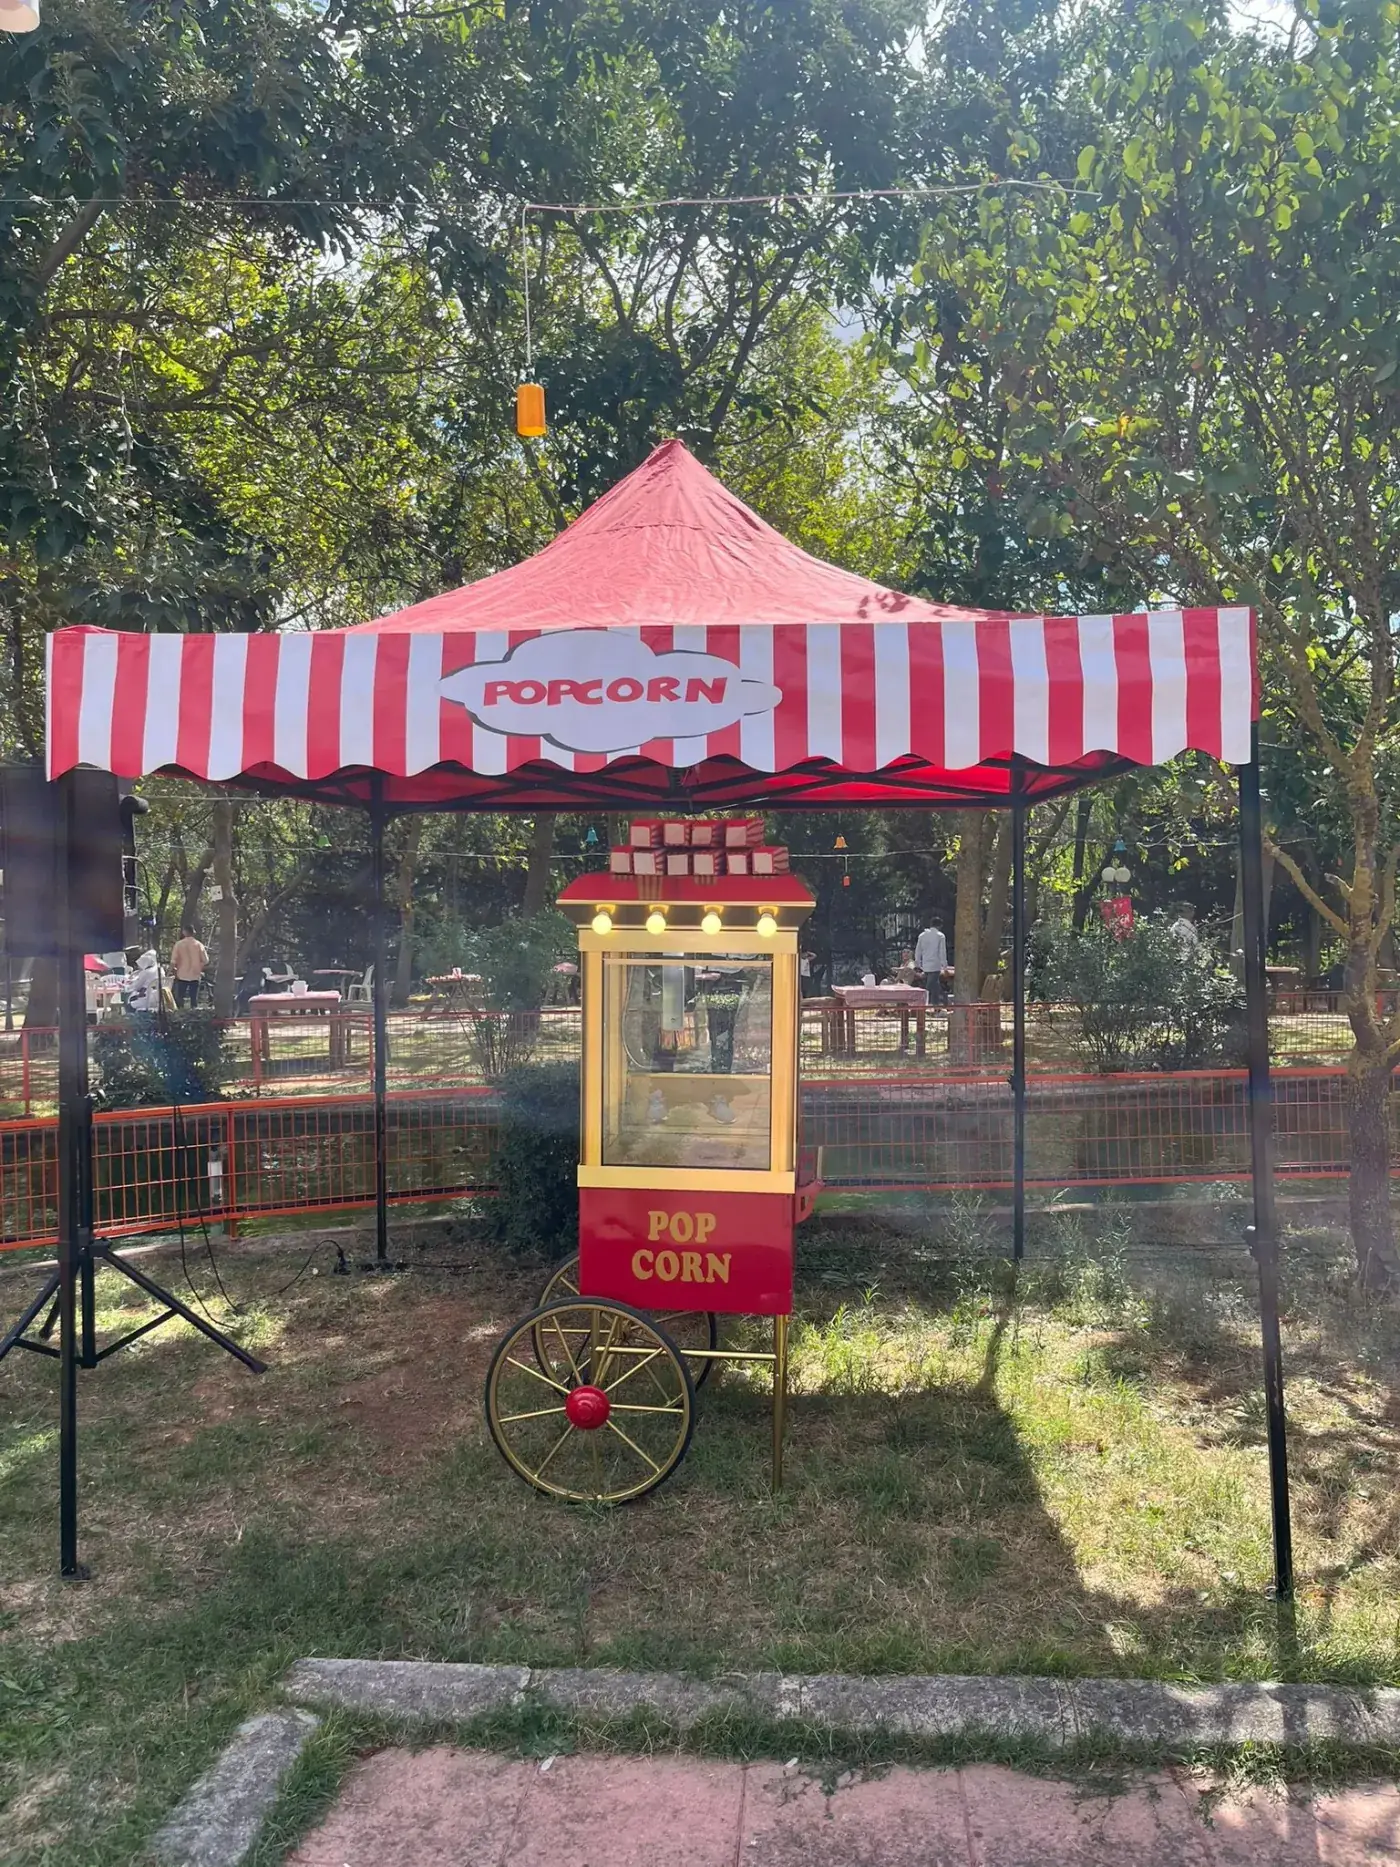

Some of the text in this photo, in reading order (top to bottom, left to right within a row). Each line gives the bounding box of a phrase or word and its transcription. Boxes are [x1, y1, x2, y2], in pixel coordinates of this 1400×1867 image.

[484, 677, 727, 706] POPCORN
[648, 1211, 716, 1243] POP
[632, 1249, 731, 1283] CORN
